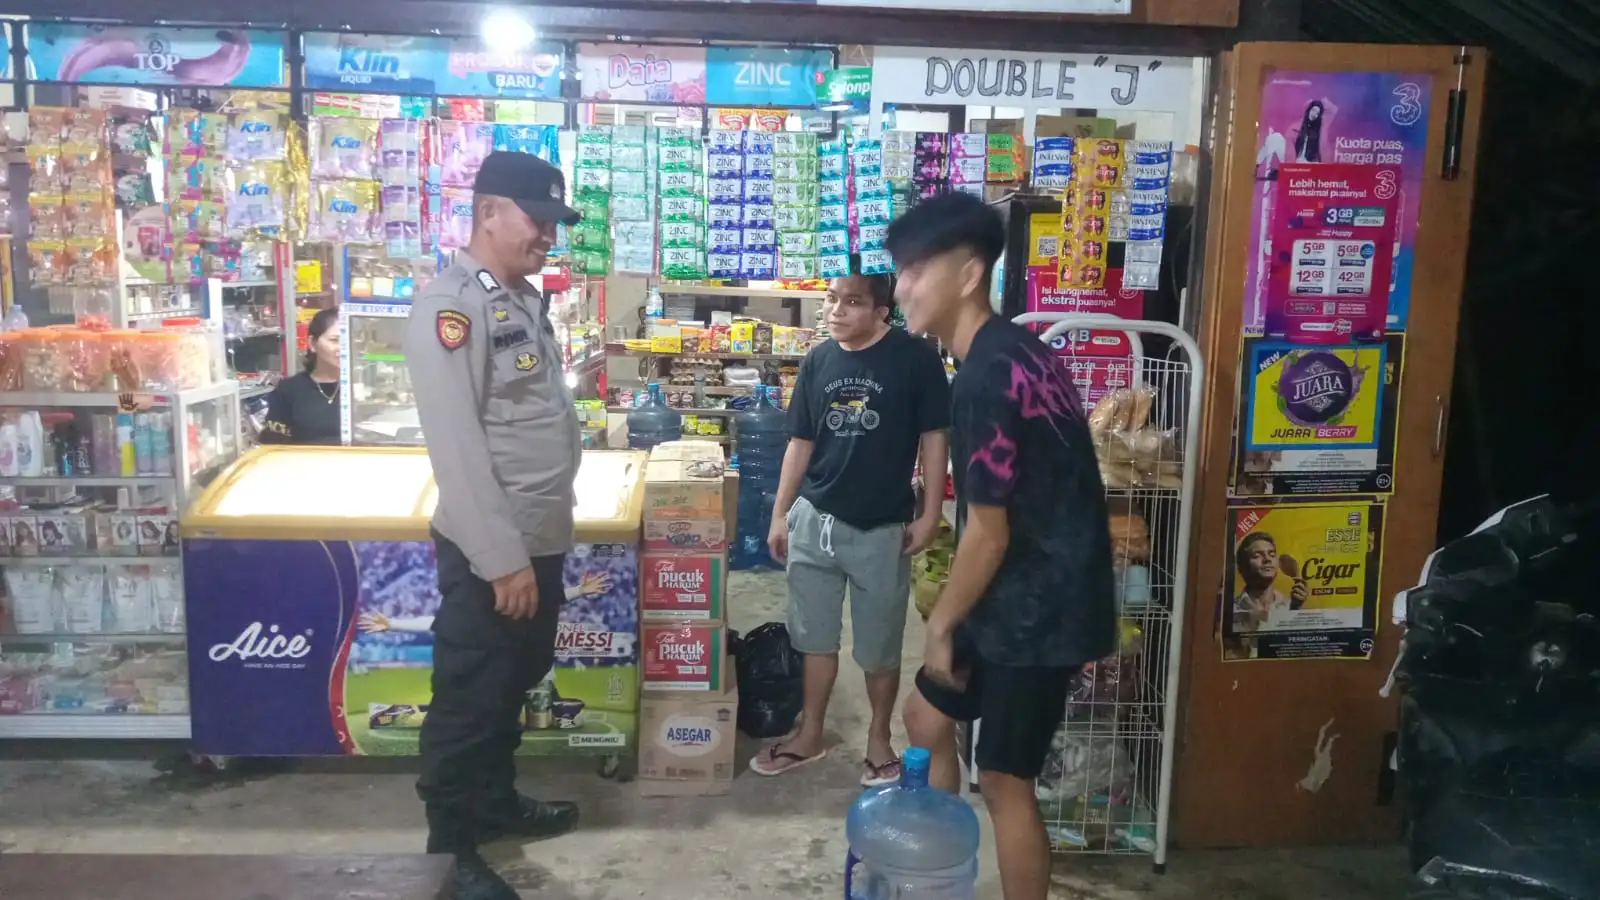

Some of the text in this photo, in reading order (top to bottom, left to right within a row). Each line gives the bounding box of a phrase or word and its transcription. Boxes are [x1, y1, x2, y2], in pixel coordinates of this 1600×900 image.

[133, 53, 180, 71] TOP
[337, 47, 400, 73] Klin
[608, 54, 672, 89] Daia
[735, 62, 791, 86] ZINC
[340, 75, 371, 85] LIQUID
[496, 74, 537, 89] BARU
[925, 56, 1077, 101] DOUBLE
[1390, 82, 1421, 126] 3
[240, 120, 272, 133] Klin
[753, 132, 772, 141] ZINC
[1138, 142, 1169, 150] PANTENE
[1335, 136, 1404, 152] Kuota puas,
[583, 147, 604, 156] ZINC
[666, 150, 686, 159] ZINC
[715, 158, 736, 167] ZINC
[753, 158, 771, 167] ZINC
[861, 153, 879, 162] ZINC
[1334, 151, 1402, 165] harga pas
[583, 172, 605, 181] ZIN
[1136, 167, 1166, 176] PANTENE
[667, 175, 687, 185] ZINC
[862, 179, 880, 188] ZINC
[1289, 178, 1350, 190] Lebih hemat,
[239, 183, 270, 197] Klin
[715, 183, 735, 193] ZINC
[751, 183, 770, 192] ZINC
[820, 183, 838, 193] ZINC
[1133, 192, 1165, 201] PANTENE
[1288, 188, 1328, 198] maksimal
[328, 199, 358, 214] Klin
[668, 201, 688, 210] ZINC
[864, 204, 882, 213] ZINC
[715, 208, 735, 217] ZINC
[751, 208, 770, 217] ZINC
[821, 208, 838, 217] ZINC
[1326, 208, 1338, 224] 3
[1338, 208, 1353, 218] GB
[1131, 217, 1162, 226] PANTENE
[669, 225, 688, 234] ZINC
[865, 229, 884, 238] ZINC
[714, 233, 734, 242] ZINC
[750, 232, 769, 241] ZINC
[821, 234, 838, 243] ZINC
[1302, 242, 1325, 255] 5 GB
[1337, 245, 1360, 257] 5 GB
[670, 251, 690, 260] ZINC
[867, 254, 886, 262] ZINC
[714, 257, 733, 267] ZINC
[748, 257, 768, 266] ZINC
[823, 259, 840, 267] ZINC
[1296, 270, 1325, 283] 12 GB
[1338, 271, 1365, 282] 42 GB
[1041, 286, 1052, 294] Isi
[1041, 296, 1076, 306] ekstra
[1259, 351, 1281, 371] NEW
[824, 379, 843, 394] DEUS
[1293, 375, 1345, 401] JUARA
[1270, 427, 1354, 439] JUARA BERRY
[1238, 510, 1261, 533] NEW
[1325, 527, 1362, 542] ESSE
[655, 559, 676, 572] Teh
[1301, 557, 1360, 586] Cigar
[658, 568, 704, 588] pucuk
[666, 581, 701, 589] HARUM
[208, 621, 312, 662] Aice
[556, 632, 614, 648] MESSI
[655, 631, 676, 644] Teh
[659, 640, 705, 660] pucuk
[666, 727, 712, 742] ASEGAR
[580, 736, 620, 744] MENGNIU
